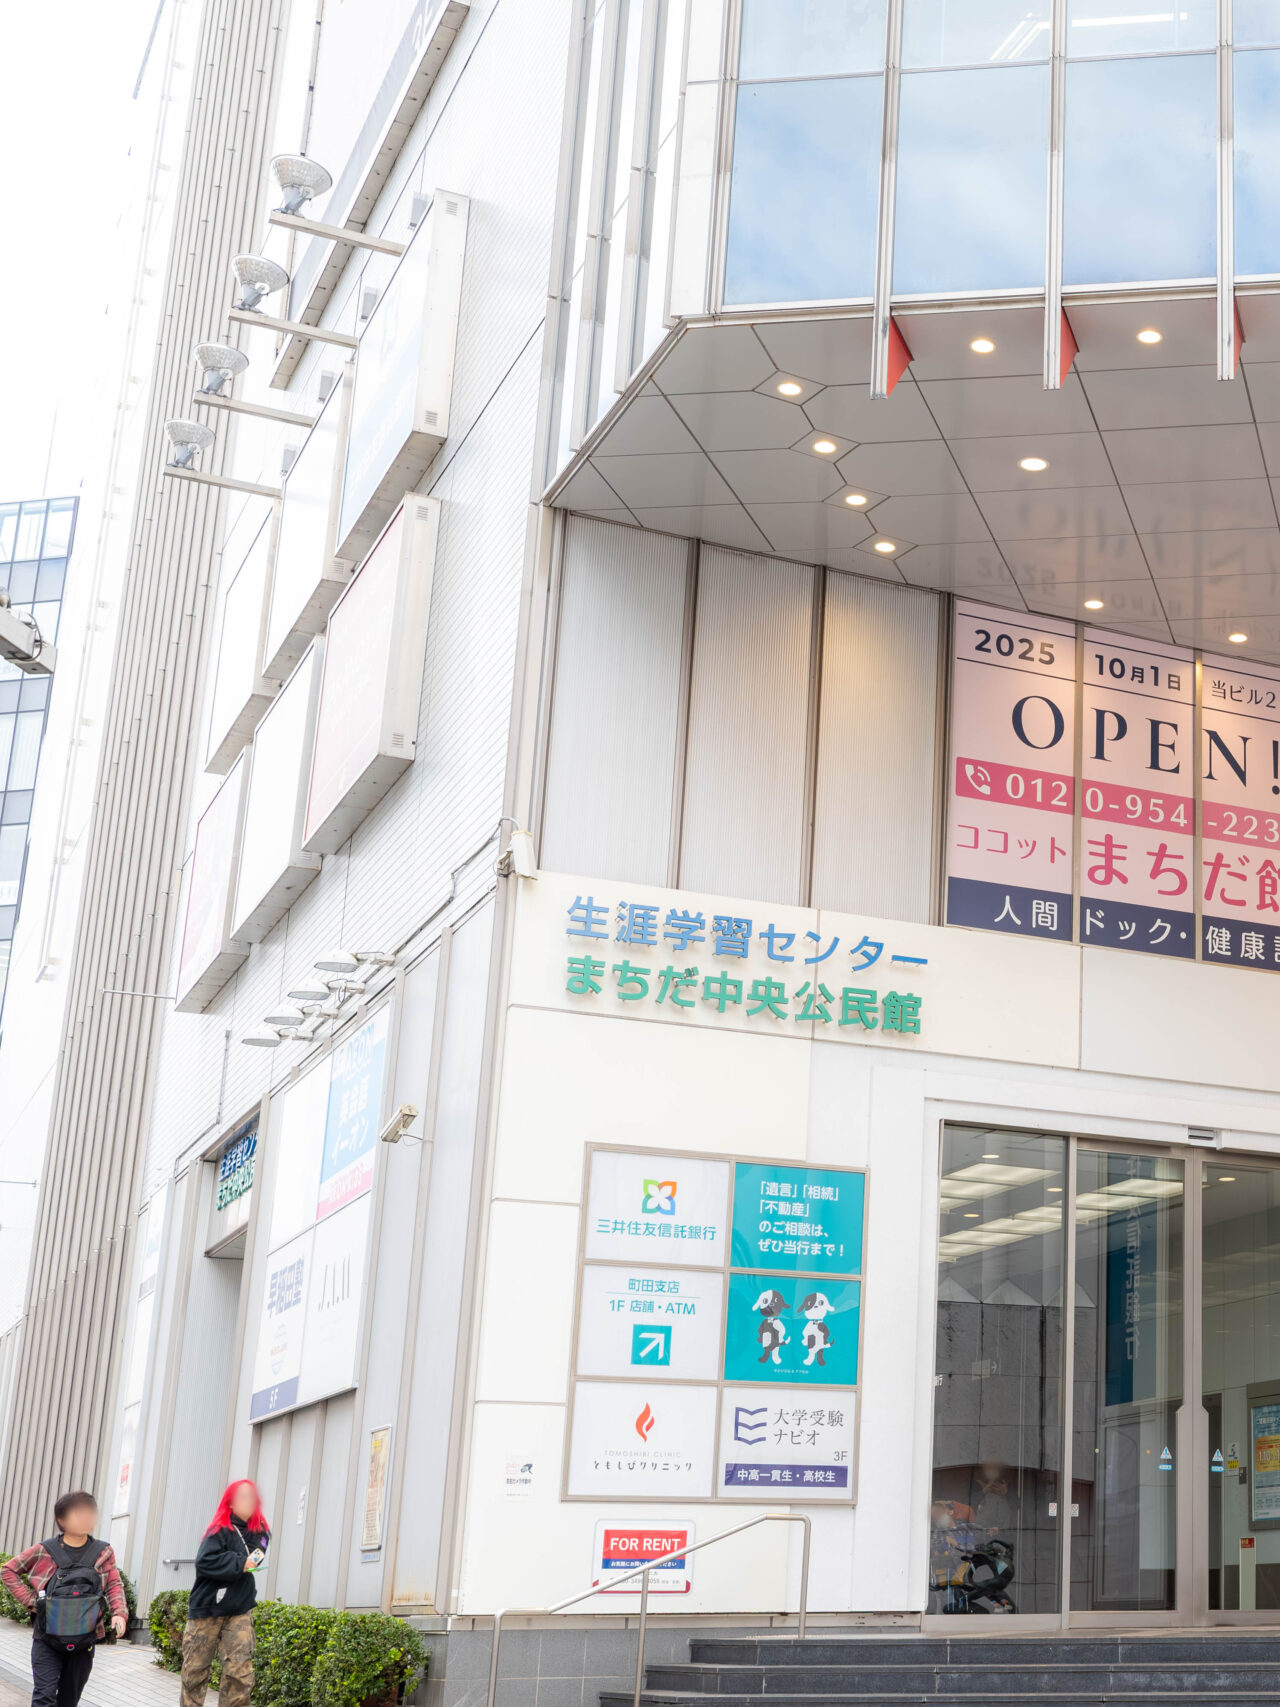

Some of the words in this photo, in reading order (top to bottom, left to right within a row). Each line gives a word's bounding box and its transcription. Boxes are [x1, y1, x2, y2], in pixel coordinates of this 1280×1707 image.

[974, 629, 1056, 666] 2025
[1094, 653, 1182, 693] 10月1日
[1011, 695, 1280, 796] OPEN!
[1005, 772, 1280, 844] 0120-954-223
[956, 824, 1067, 864] ココット
[565, 895, 928, 972] 生涯学習センター
[566, 955, 922, 1034] まちだ中央公民館
[760, 1200, 809, 1217] 「不動産」
[596, 1219, 717, 1241] 三井住友信託銀行
[759, 1220, 829, 1237] のご相談は、
[758, 1239, 844, 1256] ぜひ当行まで！
[628, 1278, 680, 1294] 町田支店
[609, 1300, 625, 1312] 1F
[630, 1300, 696, 1315] 店舗・ATM
[774, 1408, 844, 1427] 大学受験
[774, 1430, 820, 1446] ナビオ
[834, 1451, 848, 1462] 3F
[594, 1460, 692, 1472] ともしびクリニック
[738, 1469, 836, 1483] 中高一貫生・高校生
[610, 1538, 639, 1551] FOR
[643, 1538, 680, 1551] RENT
